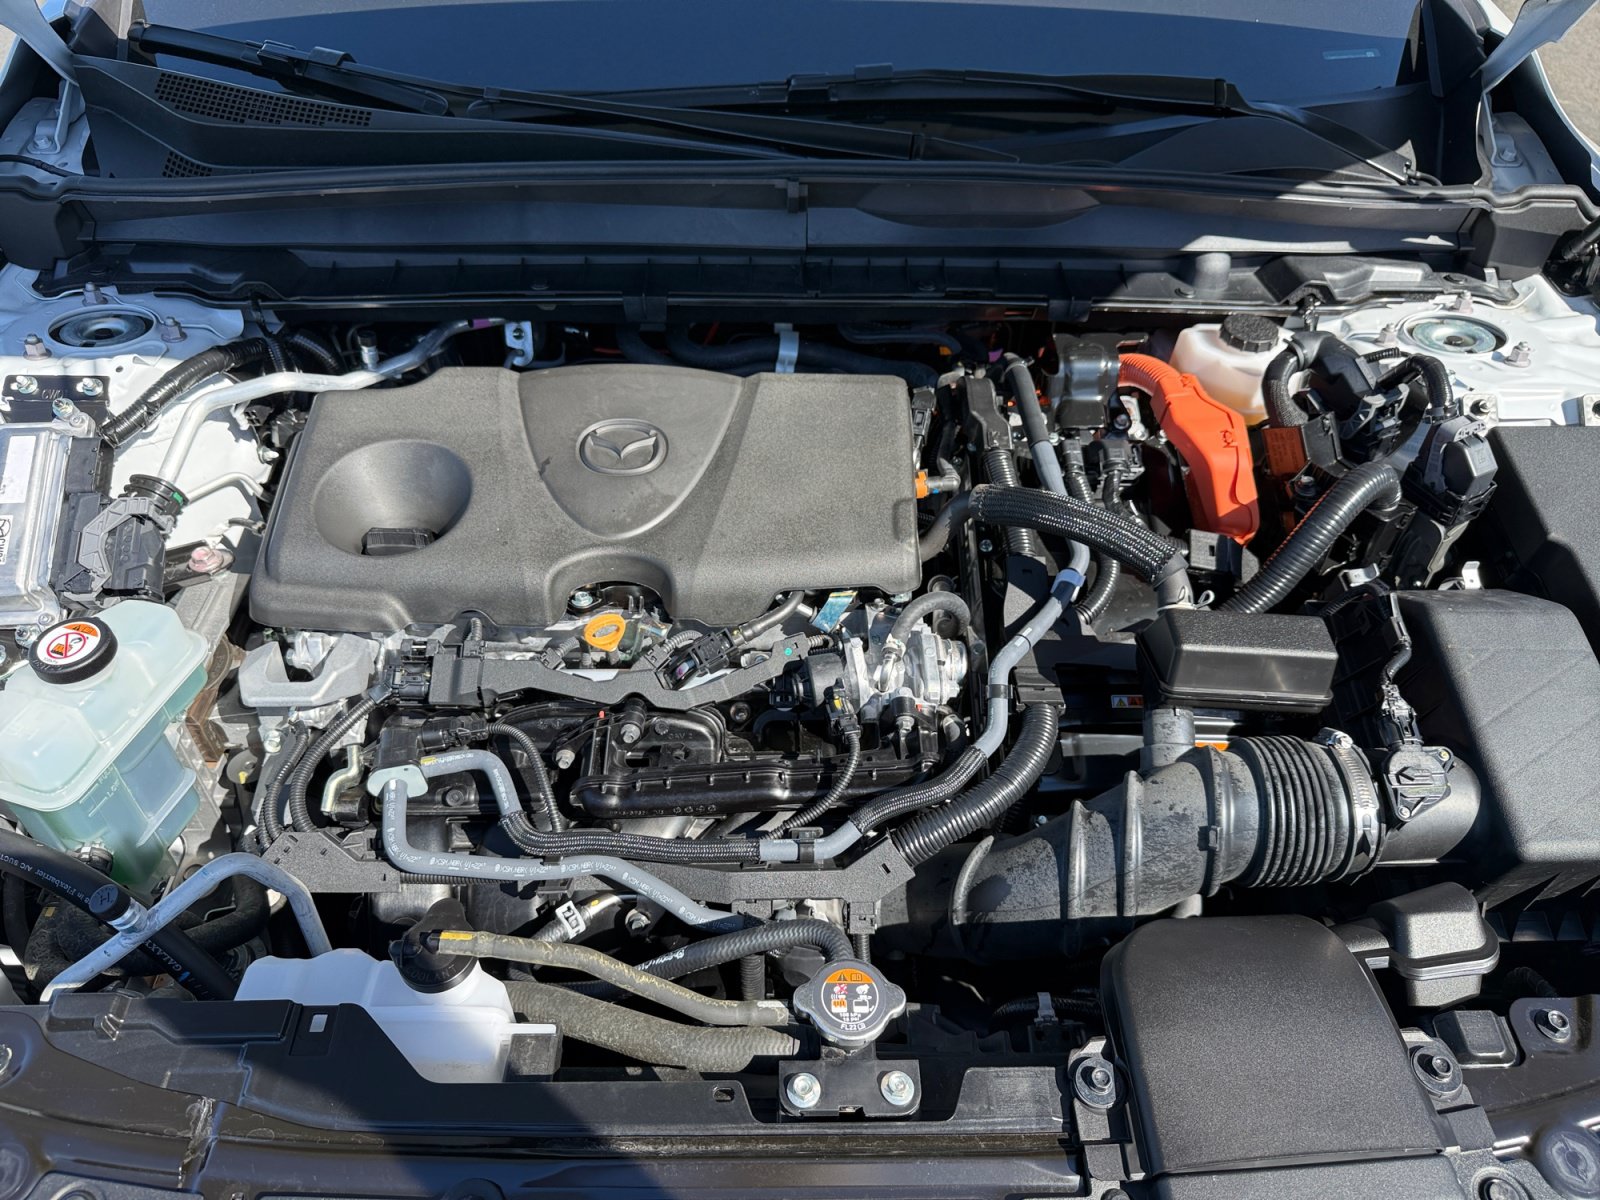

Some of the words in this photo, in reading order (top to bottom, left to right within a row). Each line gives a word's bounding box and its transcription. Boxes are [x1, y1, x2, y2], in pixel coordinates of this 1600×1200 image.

[20, 861, 33, 872] A/C
[35, 869, 77, 896] Flexbarrier
[841, 1022, 857, 1031] FL22
